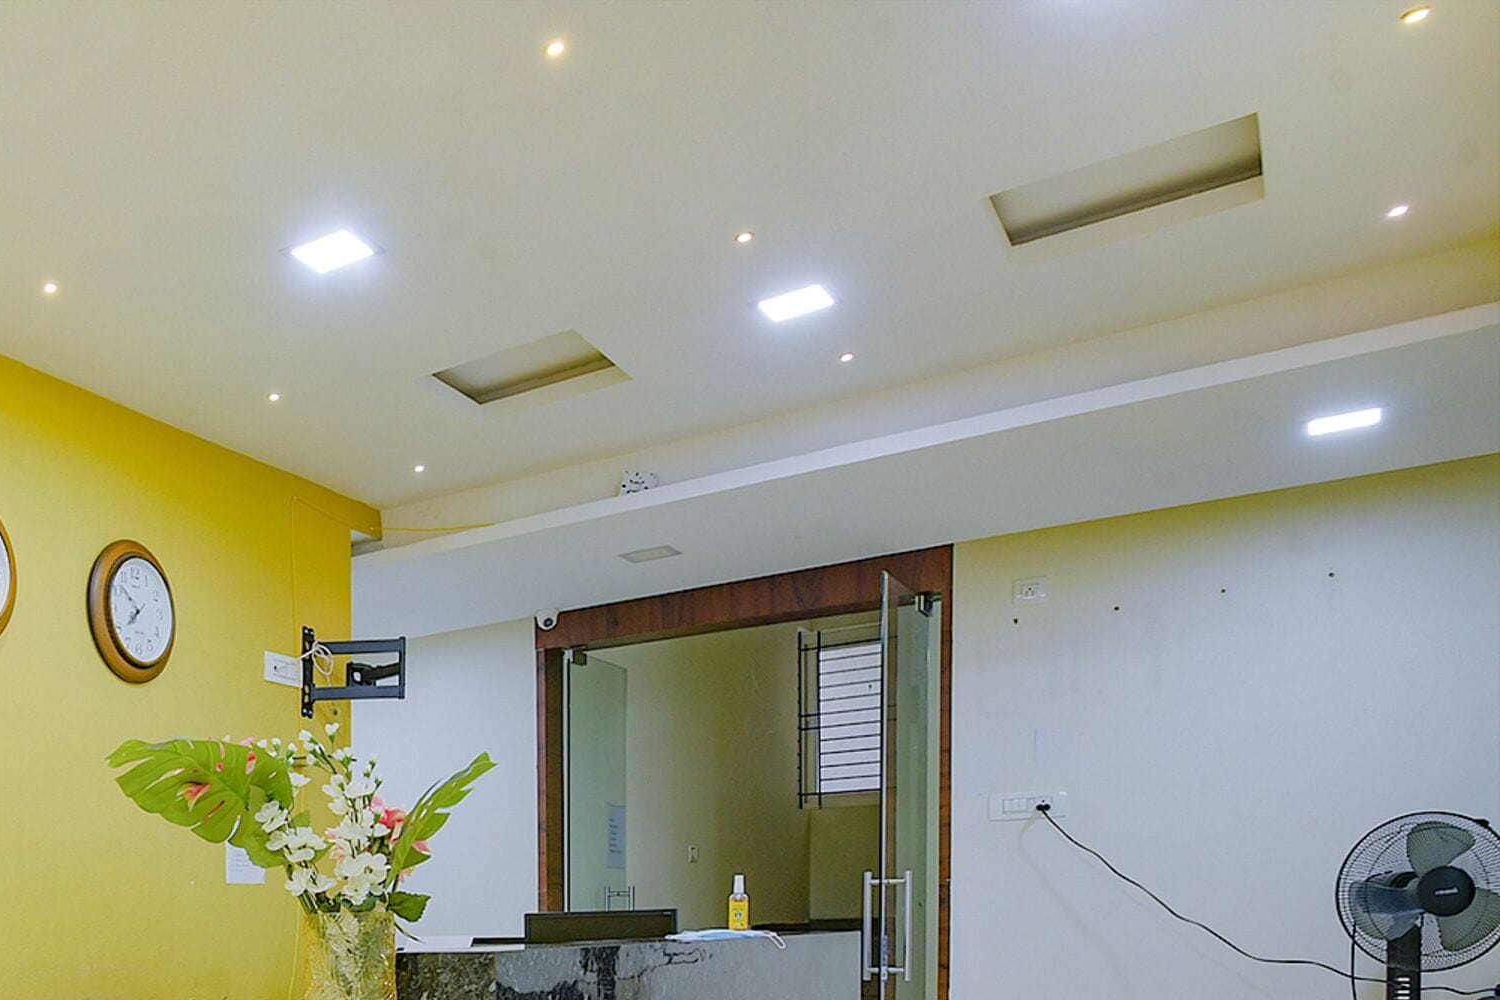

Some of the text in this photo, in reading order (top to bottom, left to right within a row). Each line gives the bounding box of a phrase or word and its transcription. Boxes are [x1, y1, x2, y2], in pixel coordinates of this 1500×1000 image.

[130, 567, 139, 580] 12
[152, 591, 158, 602] 2
[156, 609, 162, 621] 3
[136, 644, 143, 656] 6
[147, 639, 153, 652] 5
